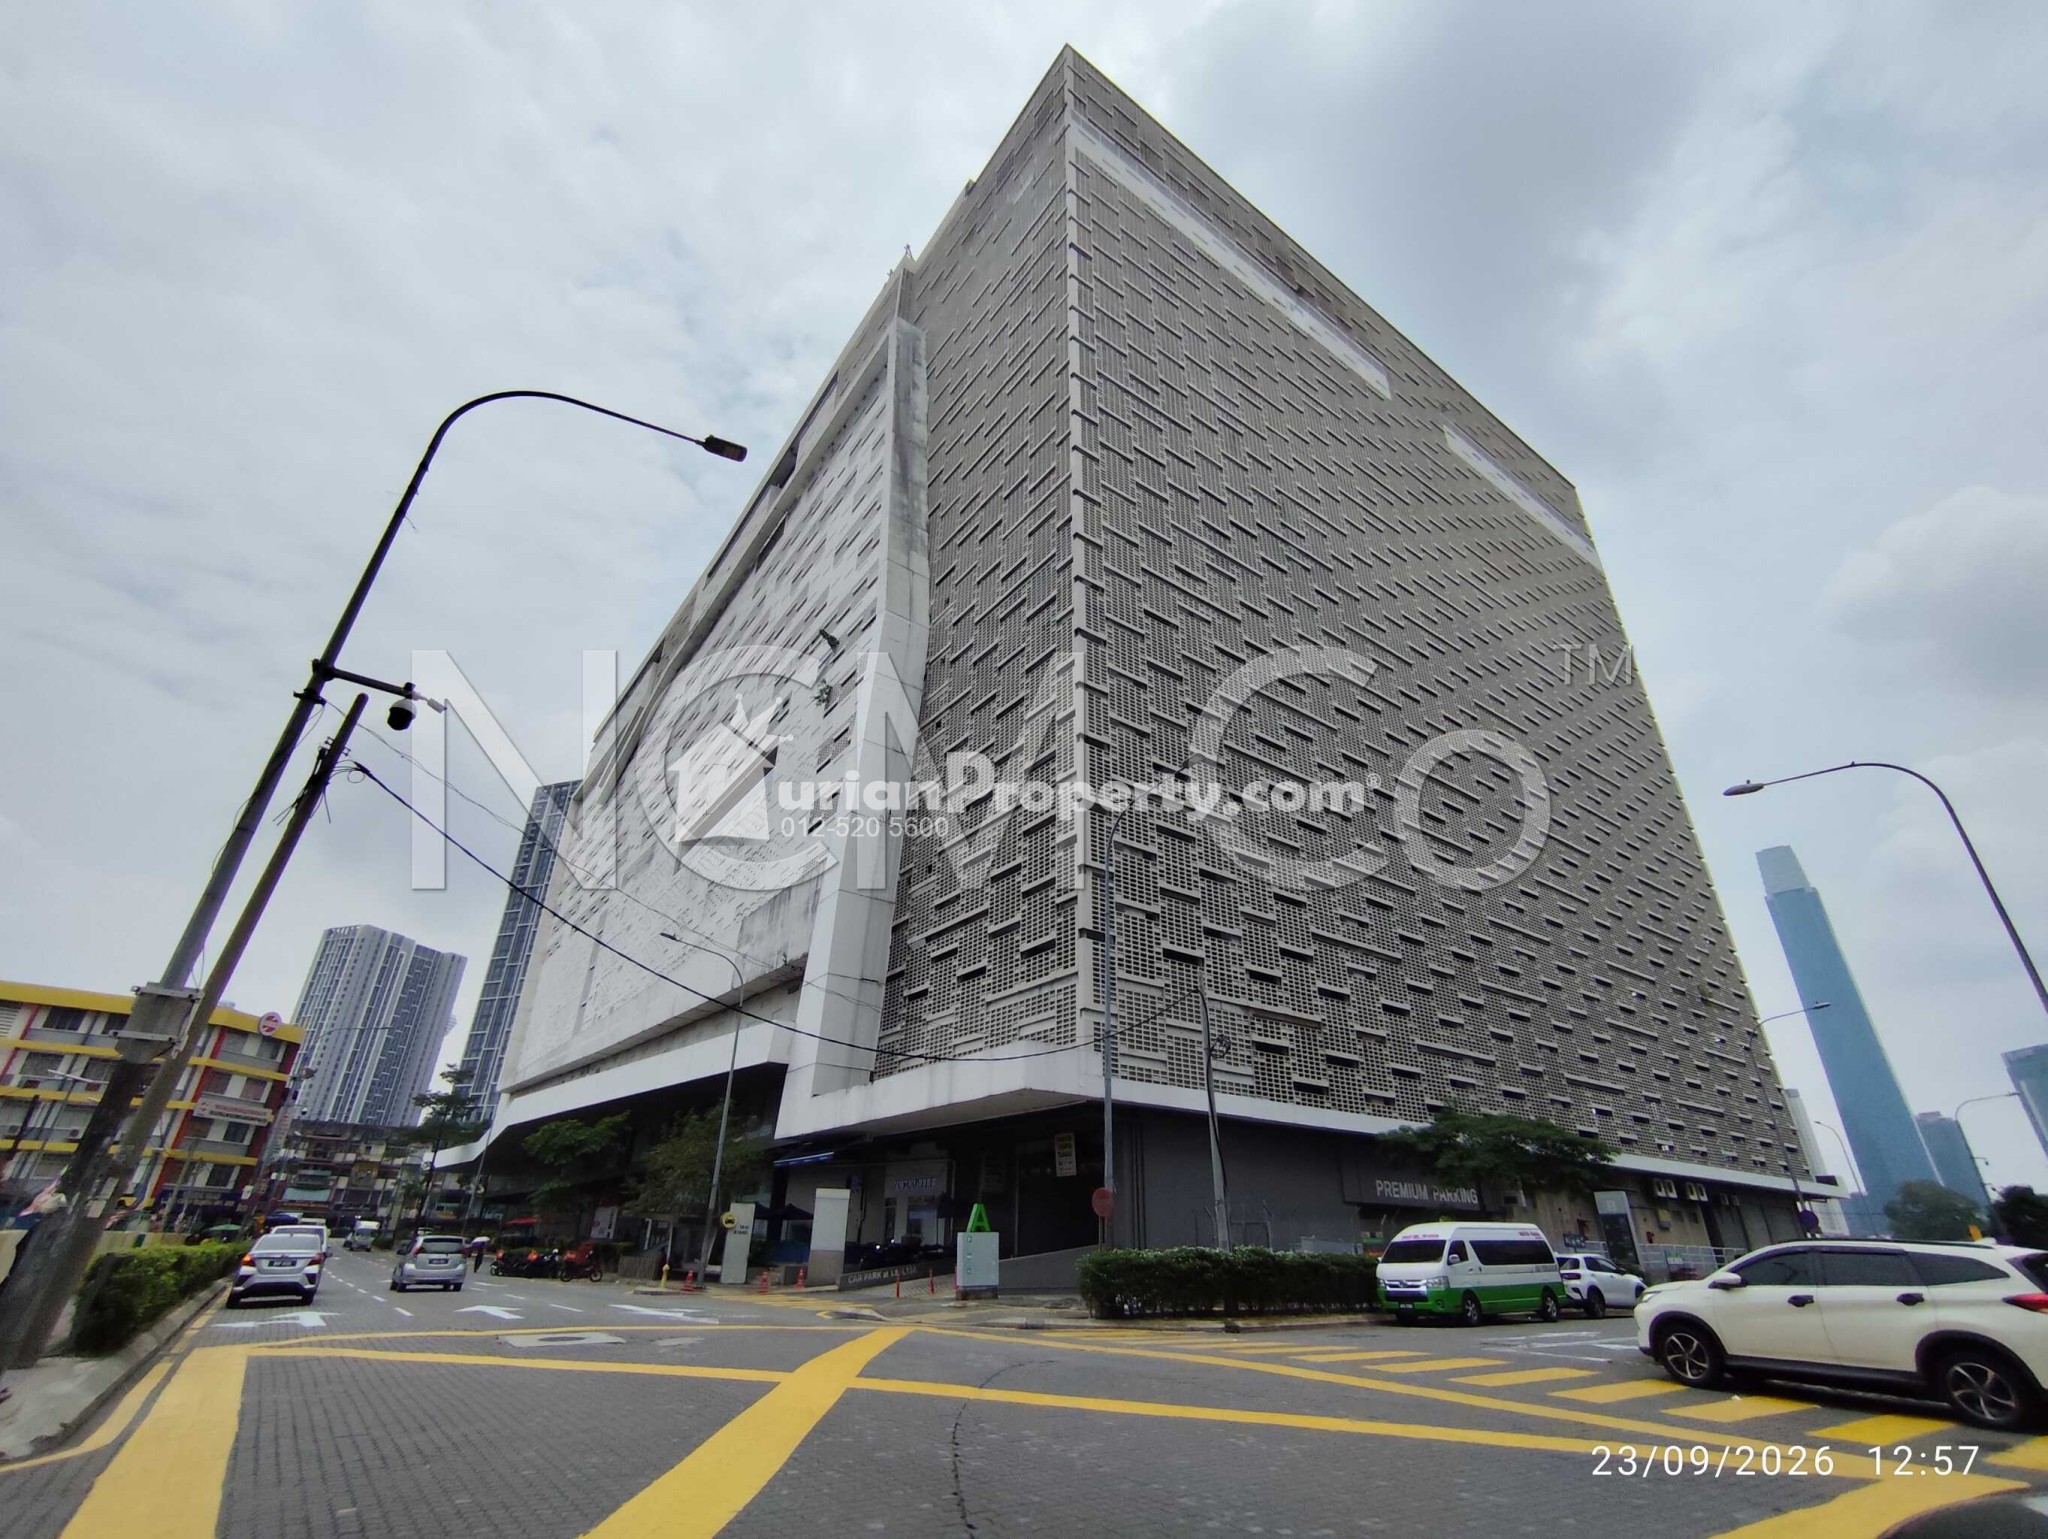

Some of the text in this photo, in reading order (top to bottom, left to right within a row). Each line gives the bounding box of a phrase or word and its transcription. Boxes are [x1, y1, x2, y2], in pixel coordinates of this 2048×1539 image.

[1375, 1180, 1479, 1205] PREMIUM PARKING
[966, 1203, 992, 1232] A
[848, 1274, 862, 1285] CAR
[863, 1271, 882, 1282] PARK
